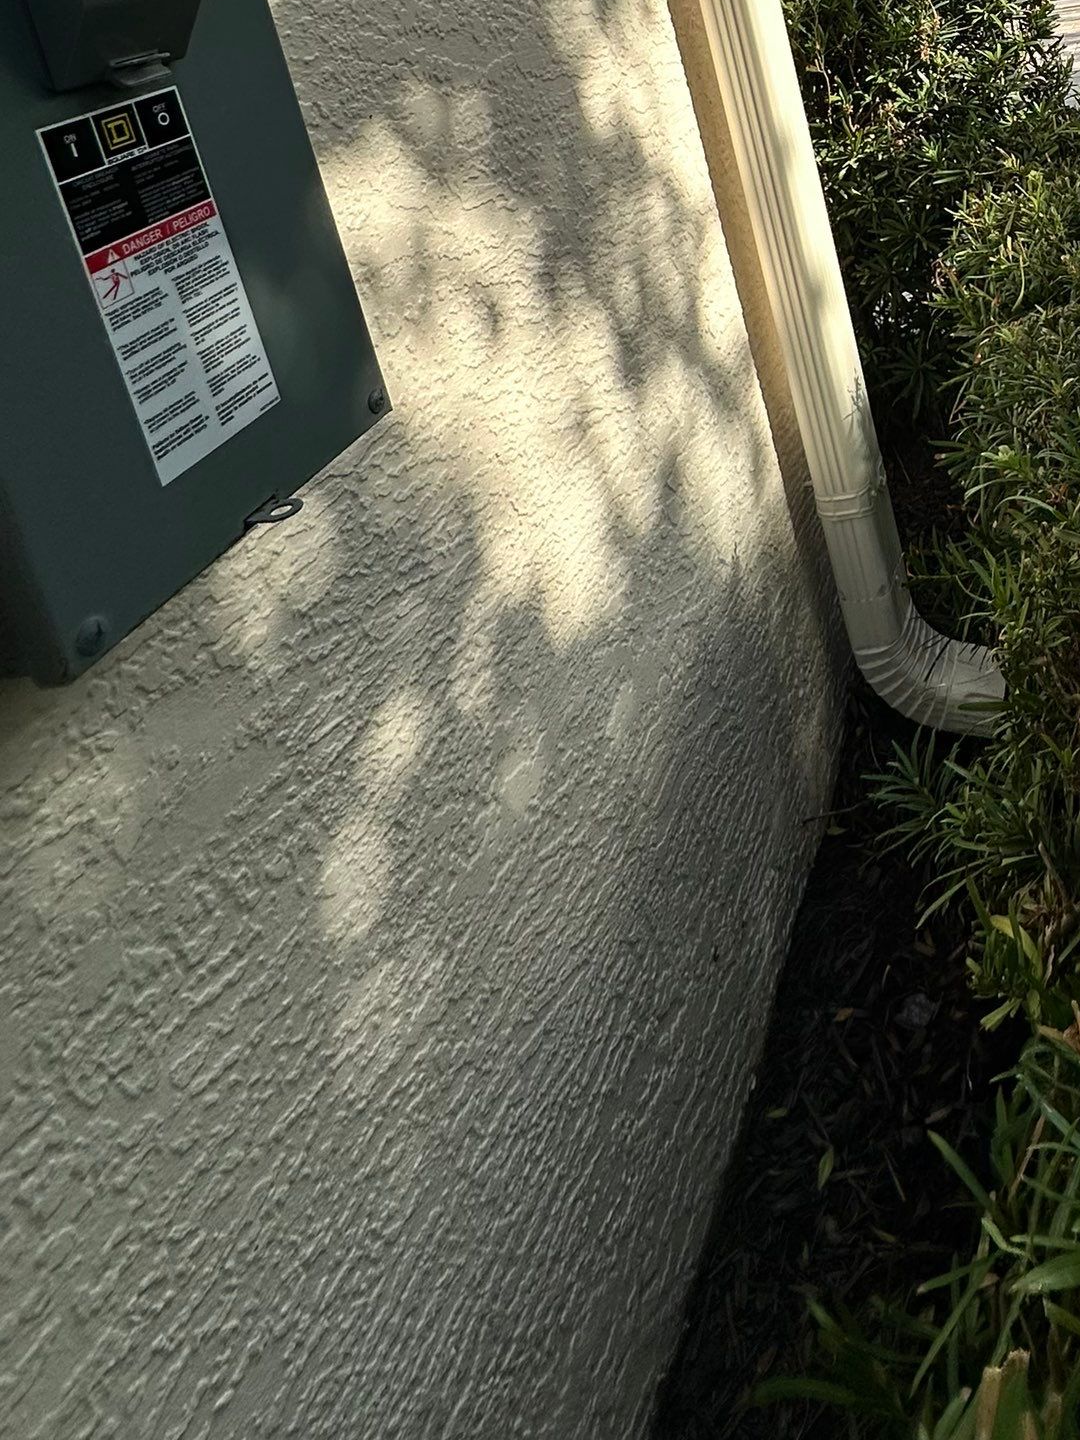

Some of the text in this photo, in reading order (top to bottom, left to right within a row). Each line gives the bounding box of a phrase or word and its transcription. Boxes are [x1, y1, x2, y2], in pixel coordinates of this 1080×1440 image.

[63, 134, 77, 143] ON
[107, 119, 130, 144] D
[108, 151, 135, 165] SQUARE
[122, 229, 163, 254] DANGER
[173, 206, 210, 231] PELIGRO
[181, 236, 190, 246] ARC
[191, 229, 208, 240] FLASH
[134, 248, 156, 261] HAZARD
[166, 231, 190, 246] ELECTRIC
[183, 241, 209, 258] DESTELLO
[130, 262, 154, 277] PELIGRO
[163, 244, 191, 261] DESCARGA
[164, 264, 176, 274] POR
